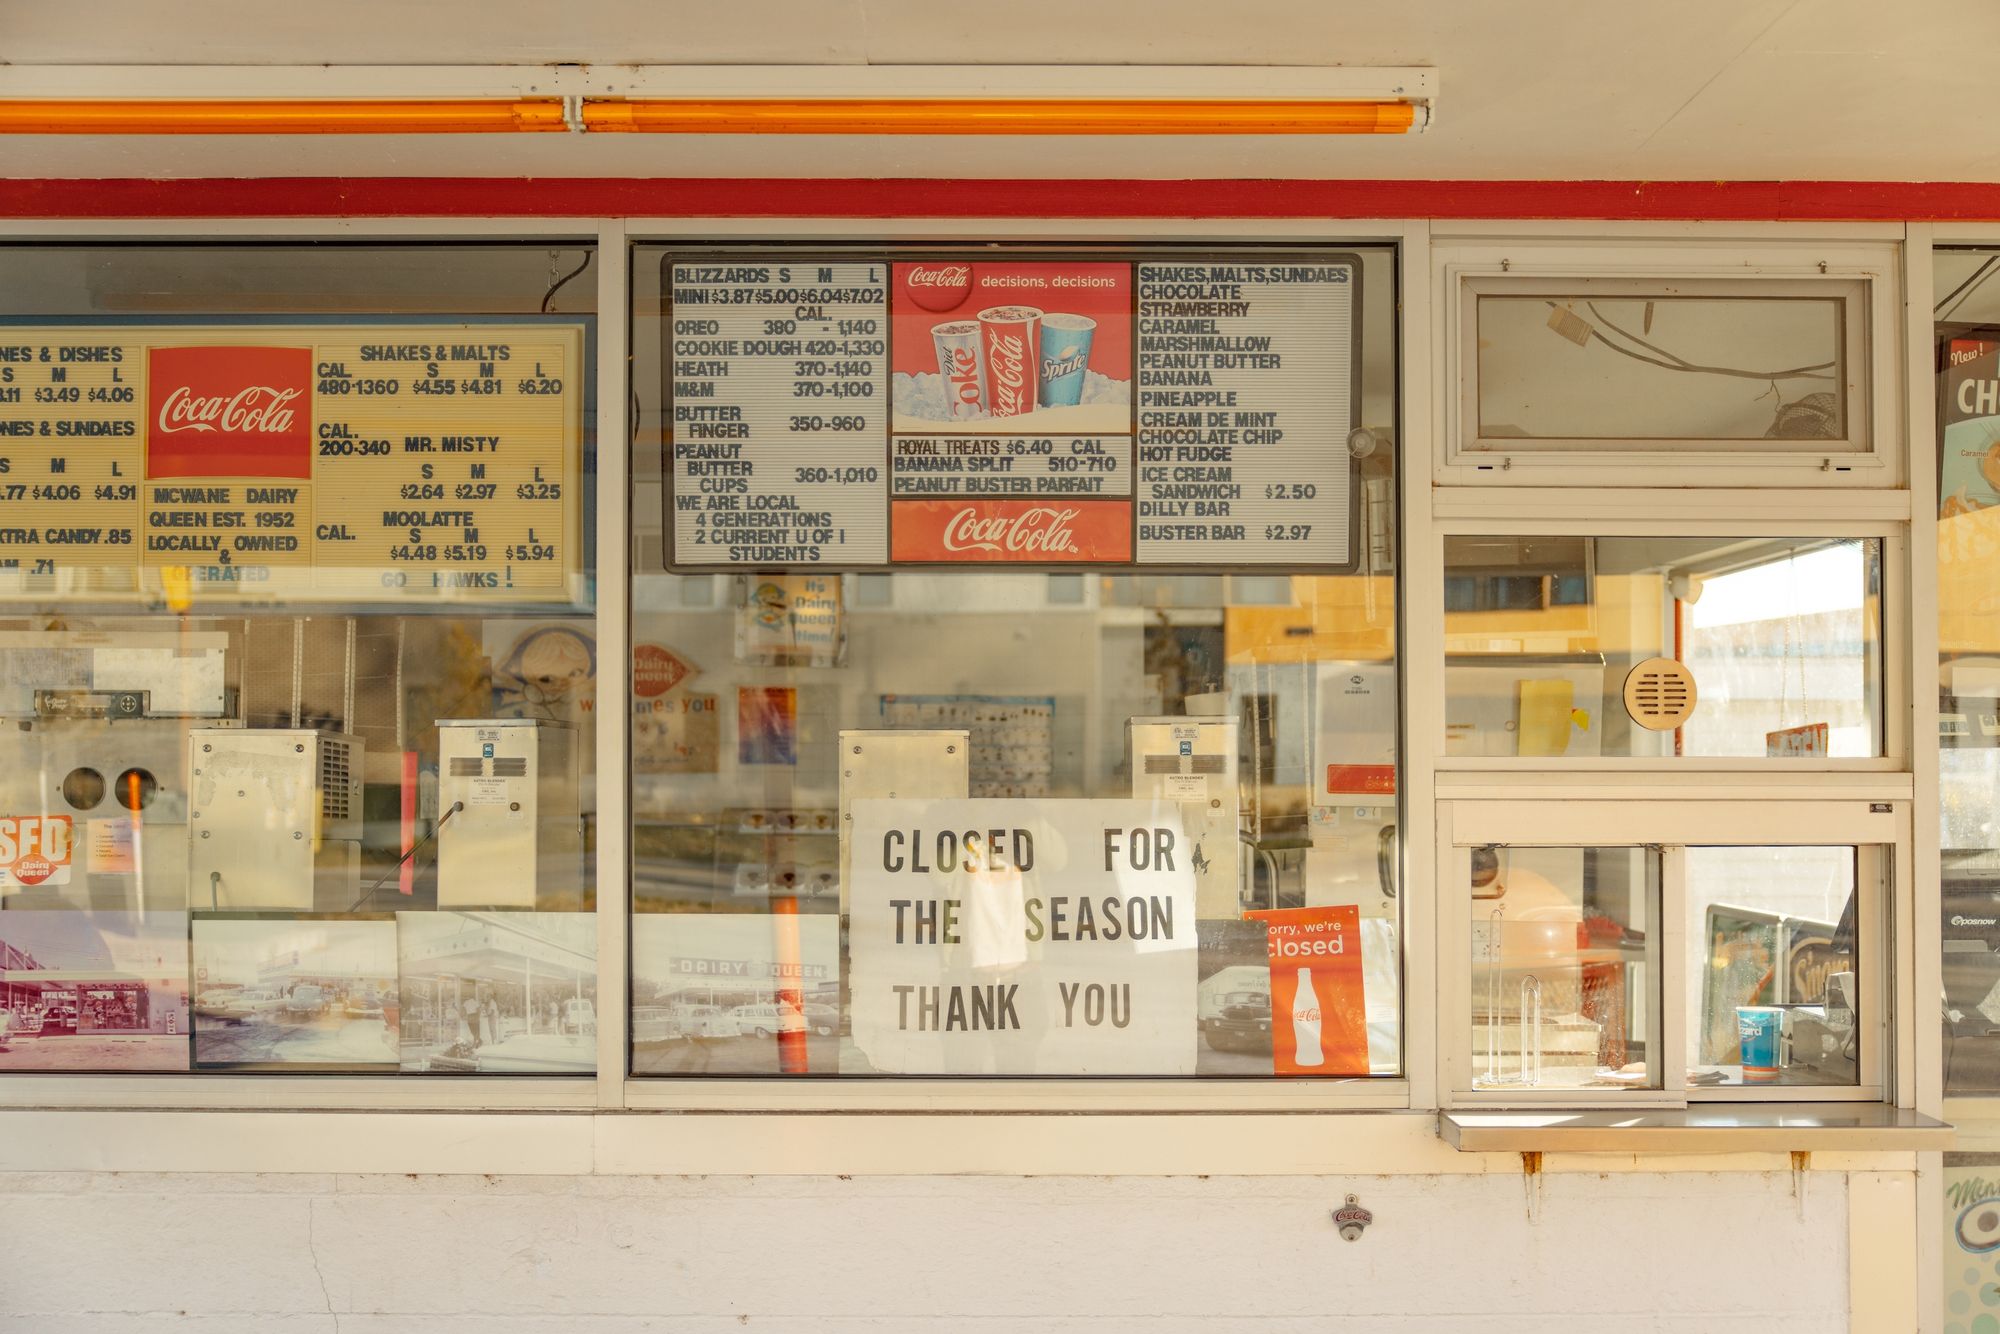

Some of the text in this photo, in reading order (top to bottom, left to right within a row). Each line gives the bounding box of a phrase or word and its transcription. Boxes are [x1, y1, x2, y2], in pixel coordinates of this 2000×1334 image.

[675, 268, 769, 283] BLIZZARDS
[908, 266, 1116, 289] Coca-Cola decisions, decisions
[674, 289, 708, 304] MINI
[1140, 285, 1241, 299] CHOCOLATE
[795, 306, 832, 321] CAL.
[1140, 302, 1250, 317] STRAWBERRY
[675, 320, 719, 335] OREO
[763, 320, 796, 335] 380
[1140, 320, 1220, 334] CARAMEL
[675, 341, 738, 356] COOKIE
[743, 341, 800, 356] DOUGH
[1141, 337, 1271, 351] MARSHMALLOW
[0, 346, 123, 362] NES & DISHES
[360, 345, 510, 361] SHAKES & MALTS
[674, 361, 728, 376] HEATH
[1042, 351, 1087, 383] Sprite
[1140, 354, 1281, 369] PEANUT BUTTER
[1140, 371, 1213, 386] BANANA
[35, 387, 80, 402] $3.49
[88, 387, 134, 402] $4.06
[413, 380, 456, 395] $4.55
[461, 380, 502, 394] $4.81
[518, 379, 563, 395] $6.20
[674, 382, 714, 397] M&M
[1141, 392, 1237, 406] PINEAPPLE
[1957, 378, 2000, 414] CH
[159, 386, 304, 433] Coca-Cola
[675, 406, 741, 421] BUTTER
[789, 416, 866, 431] 350-960
[1141, 412, 1277, 427] CREAM DE MINT
[0, 421, 135, 436] NES & SUNDAES
[318, 424, 359, 439] CAL.
[689, 423, 749, 438] FINGER
[405, 437, 437, 452] MR.
[442, 437, 499, 452] MISTY
[1139, 430, 1283, 444] CHOCOLATE CHIP
[675, 444, 742, 459] PEANUT
[898, 440, 940, 455] ROYAL
[944, 440, 1000, 454] TREATS
[1006, 440, 1053, 455] $6.40
[1140, 447, 1232, 461] HOT FUDGE
[1961, 449, 1989, 459] Caramel
[687, 461, 753, 476] BUTTER
[894, 457, 1117, 471] BANANA SPLIT 510-710
[1142, 467, 1232, 482] ICE CREAM
[400, 484, 561, 500] $2.64 $2.97 $3.25
[700, 478, 748, 493] CUPS
[894, 477, 1104, 492] PEANUT BUSTER PARFAIT
[1152, 484, 1241, 499] SANDWICH
[33, 485, 80, 500] $4.06
[95, 485, 136, 500] $4.91
[154, 488, 299, 504] MCWANE DAIRY
[676, 495, 800, 510] WE ARE LOCAL
[1140, 502, 1230, 516] DILLY BAR
[150, 512, 295, 527] QUEEN EST. 1952
[383, 511, 474, 527] MOOLATTE
[696, 512, 832, 527] 4 GENERATIONS
[45, 529, 102, 544] CANDY
[104, 529, 132, 544] .85
[316, 525, 356, 540] CAL.
[695, 529, 845, 544] 2 CURRENT U OF I
[943, 507, 1081, 552] Coca-Cola
[1140, 525, 1312, 540] BUSTER BAR $2.97
[149, 535, 298, 551] LOCALLY OWNED
[219, 549, 231, 564] &
[390, 545, 437, 561] $4.48
[444, 545, 487, 561] $5.19
[729, 546, 820, 561] STUDENTS
[31, 559, 54, 574] .71
[381, 572, 498, 588] GO HAWKS
[682, 698, 715, 713] you
[883, 828, 1176, 873] CLOSED FOR
[22, 860, 50, 870] Dairy
[17, 869, 49, 878] Queen
[890, 896, 1174, 944] THE SEASON
[1269, 921, 1342, 935] orry, we're
[681, 960, 743, 974] DAIRY
[893, 983, 1131, 1031] THANK YOU
